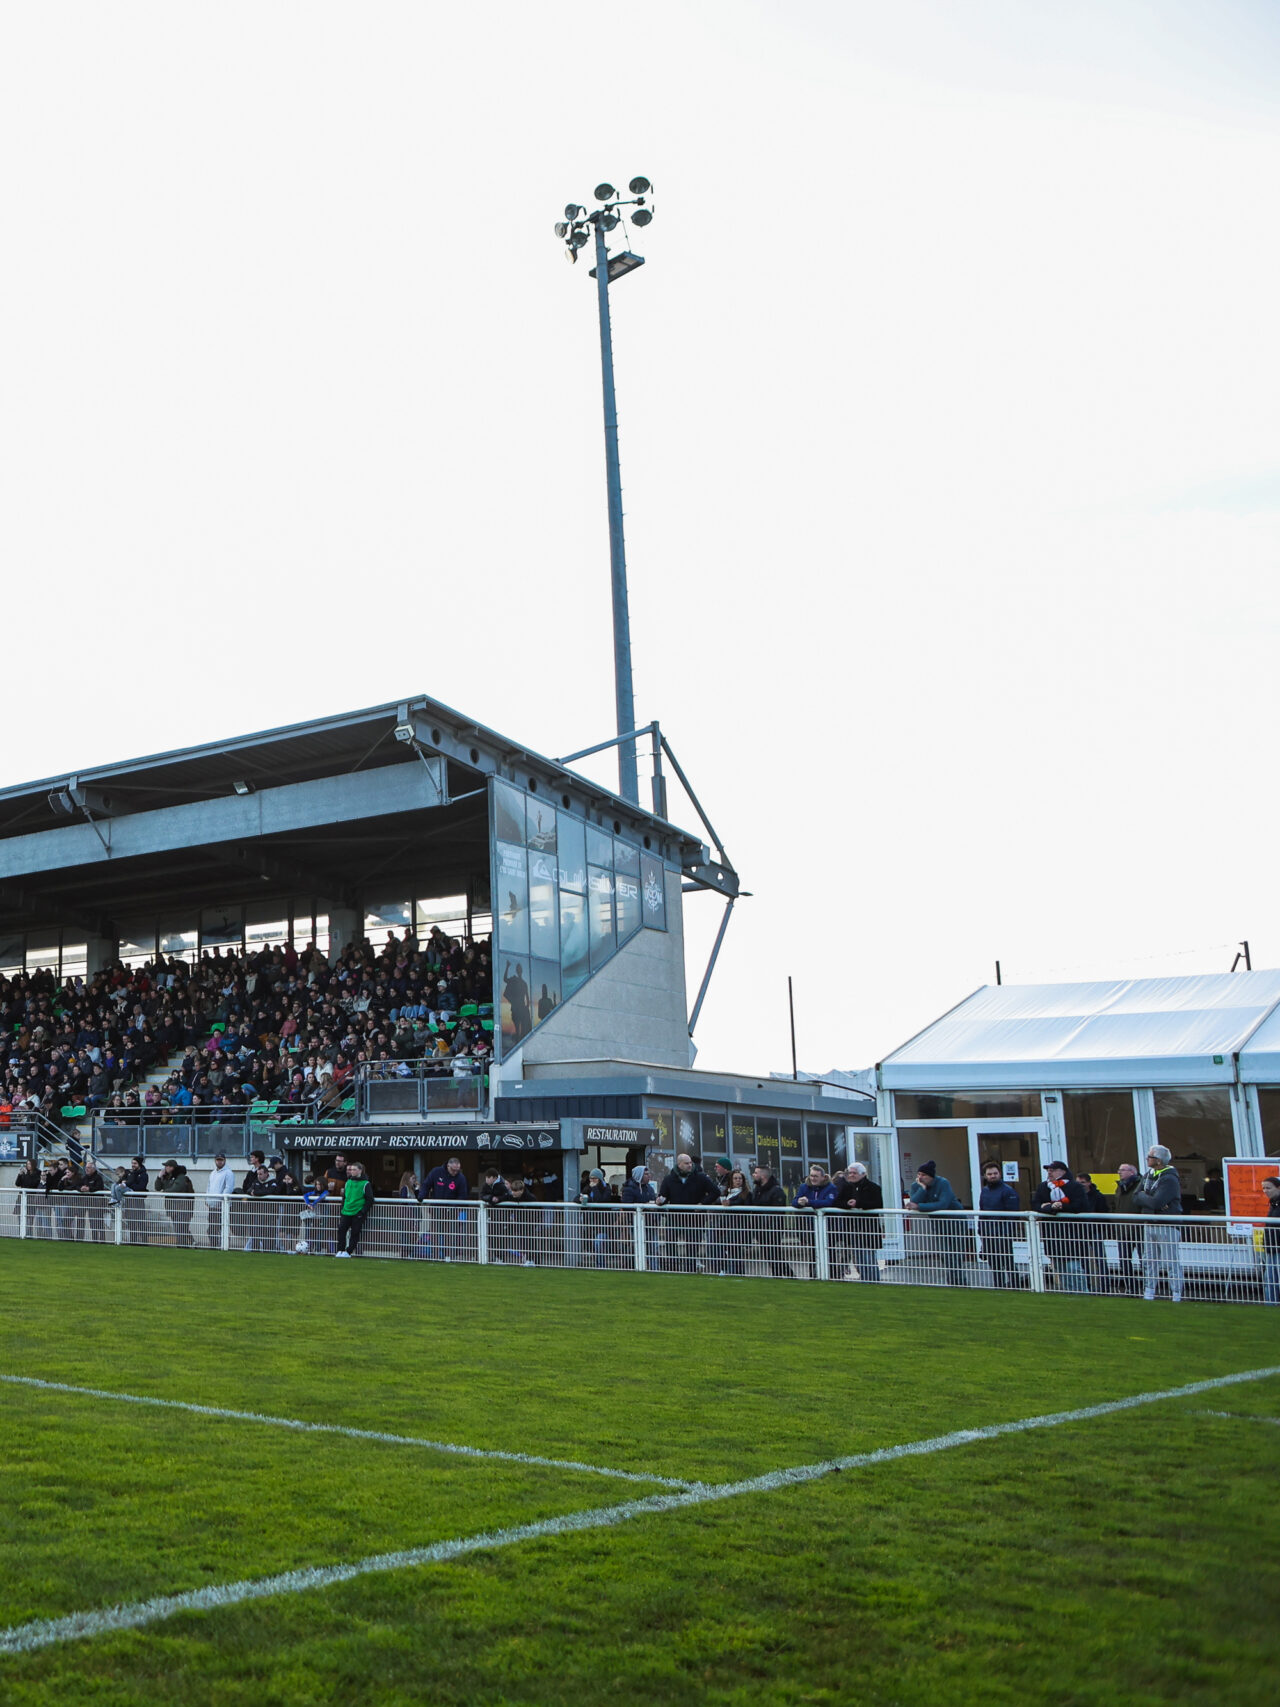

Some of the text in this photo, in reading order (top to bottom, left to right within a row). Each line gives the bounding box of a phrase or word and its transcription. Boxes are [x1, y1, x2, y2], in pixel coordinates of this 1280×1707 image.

[587, 1127, 639, 1142] RESTAURATION
[715, 1125, 725, 1138] Le
[294, 1135, 324, 1147] POINT
[324, 1135, 338, 1147] DE
[338, 1135, 382, 1147] RETRAIT
[388, 1135, 468, 1147] RESTAURATION
[22, 1141, 28, 1157] 1
